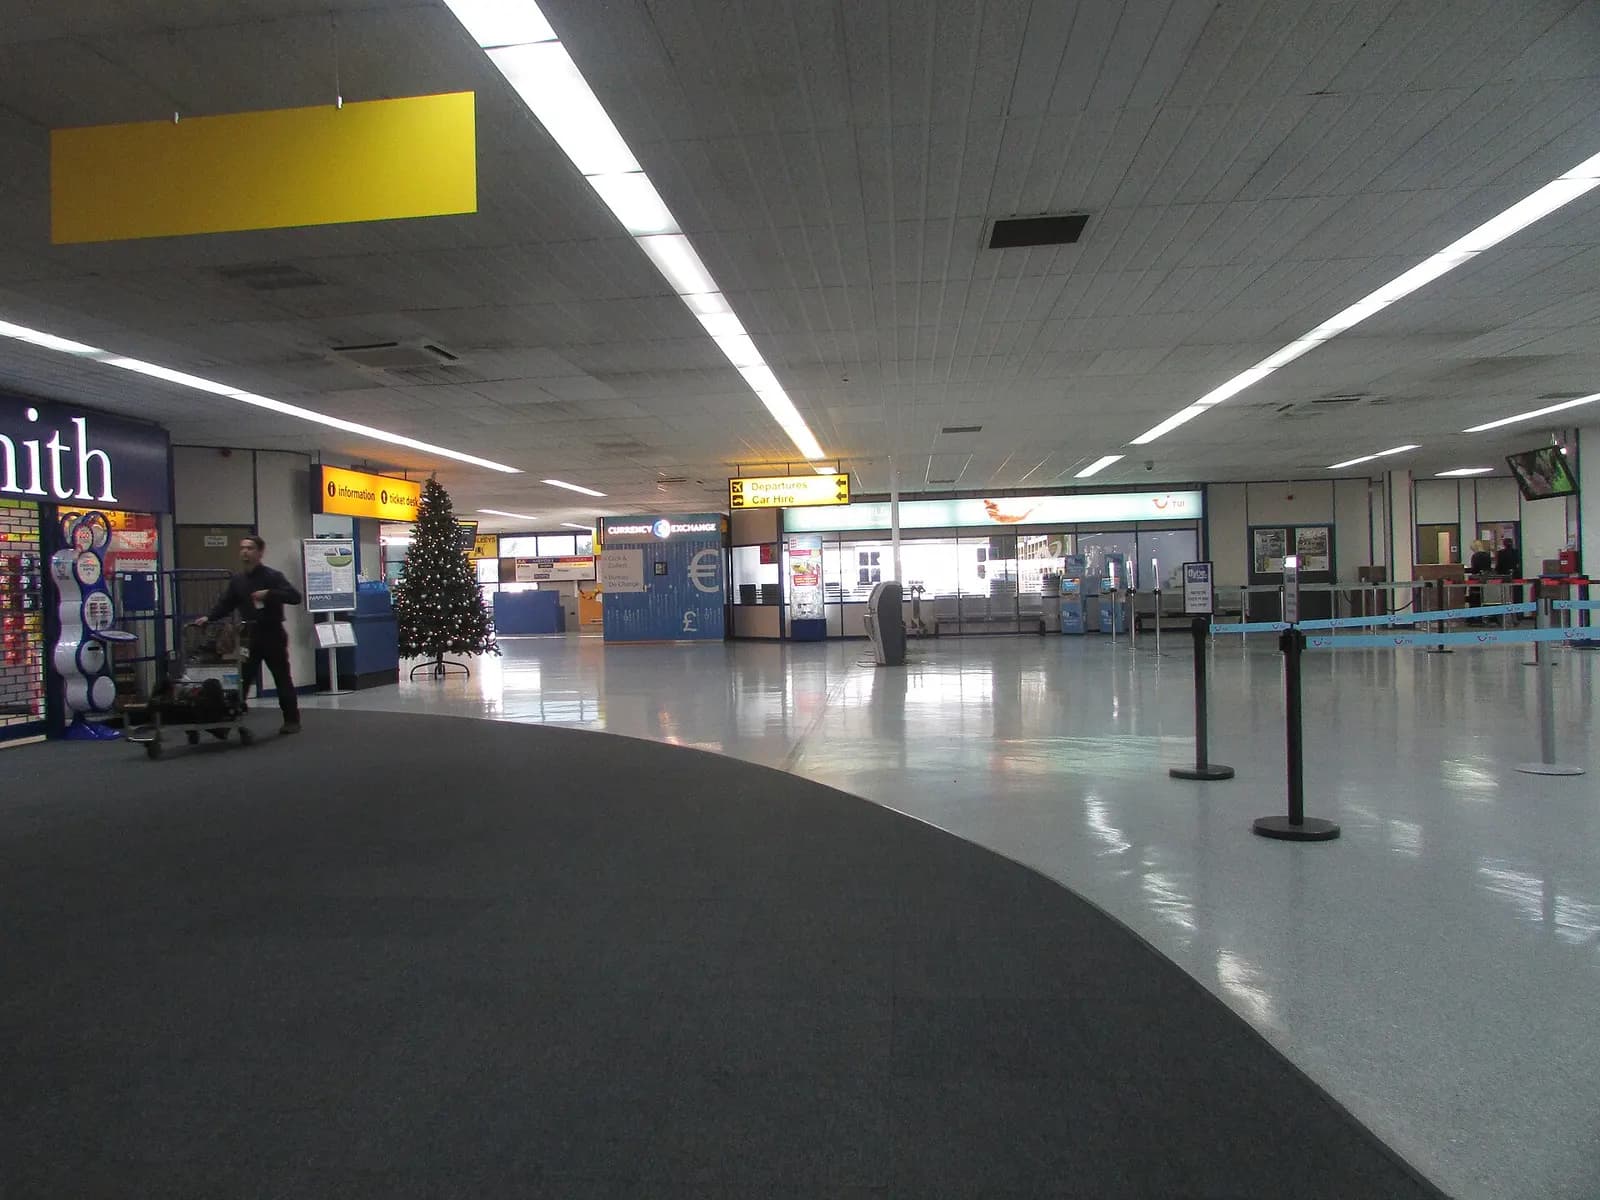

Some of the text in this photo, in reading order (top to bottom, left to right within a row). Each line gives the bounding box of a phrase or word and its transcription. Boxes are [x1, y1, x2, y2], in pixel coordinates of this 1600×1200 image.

[751, 481, 808, 492] Departures
[338, 484, 375, 501] information
[389, 493, 405, 503] ticket
[752, 494, 794, 504] Car Hire
[1172, 500, 1185, 508] TUI
[608, 523, 716, 534] CURRENCY EXCHANGE
